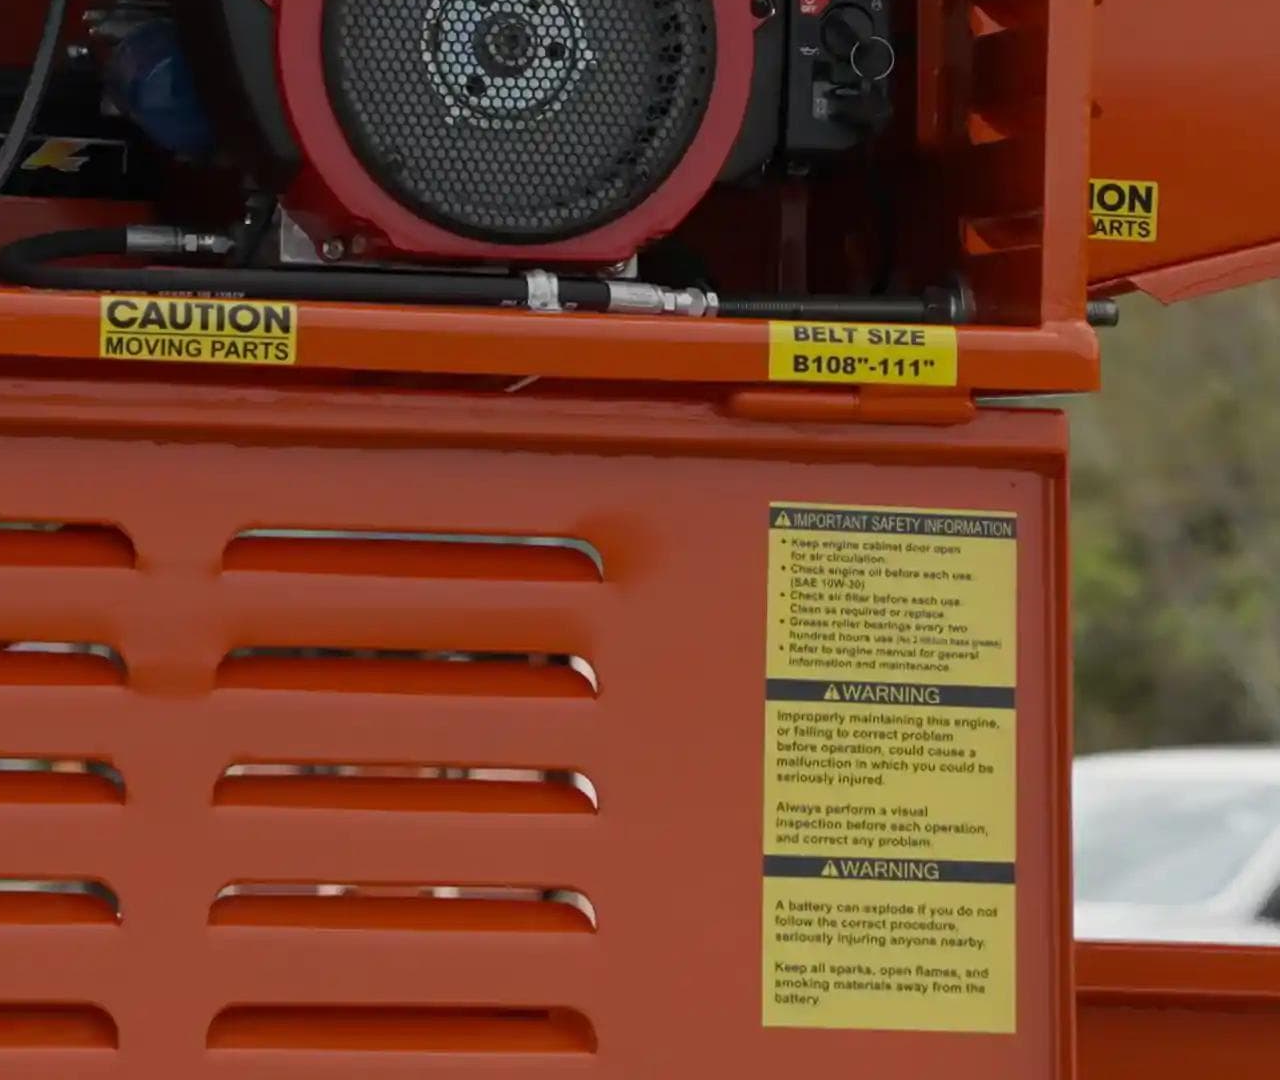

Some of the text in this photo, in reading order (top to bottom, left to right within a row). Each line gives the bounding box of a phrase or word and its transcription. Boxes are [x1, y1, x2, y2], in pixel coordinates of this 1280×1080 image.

[107, 299, 290, 334] CAUTION
[793, 325, 925, 346] BELT SIZE
[105, 336, 289, 361] MOVING PARTS
[793, 354, 935, 377] B108"-111"
[794, 514, 1011, 536] IMPORTANT SAFETY INFORMATION
[791, 537, 961, 555] Keep engine cabinet door open
[791, 550, 806, 560] for
[790, 563, 825, 574] Check
[827, 565, 865, 578] engine
[868, 566, 881, 576] oil
[884, 567, 919, 578] before
[922, 568, 949, 579] each
[789, 590, 824, 600] Check
[872, 593, 908, 603] before
[910, 594, 937, 604] each
[789, 603, 821, 613] Clean
[839, 605, 886, 618] required
[863, 618, 911, 632] bearings
[947, 622, 968, 632] two
[789, 630, 835, 642] hundred
[788, 642, 818, 653] Refer
[820, 644, 833, 653] to
[834, 644, 872, 657] engine
[918, 647, 934, 657] for
[937, 648, 979, 661] general
[788, 655, 852, 667] information
[854, 658, 876, 668] and
[842, 684, 941, 704] WARNING
[777, 711, 845, 724] Improperly
[848, 713, 923, 727] maintaining
[926, 715, 950, 725] this
[793, 726, 833, 739] failing
[836, 728, 849, 737] to
[852, 728, 897, 739] correct
[900, 729, 953, 743] problem
[777, 741, 817, 752] before
[888, 745, 924, 755] could
[927, 748, 965, 756] cause
[776, 757, 994, 773] malfunction in which you could be
[776, 772, 834, 785] seriously
[776, 802, 821, 815] Always
[825, 803, 875, 816] perform
[890, 805, 928, 815] visual
[776, 818, 842, 831] inspection
[845, 820, 886, 830] before
[889, 821, 920, 831] each
[776, 833, 799, 843] and
[802, 834, 848, 844] correct
[851, 837, 874, 847] any
[840, 860, 940, 880] WARNING
[775, 900, 784, 910] A
[788, 901, 832, 913] battery
[836, 904, 859, 912] can
[862, 903, 914, 916] explode
[917, 904, 925, 914] if
[929, 907, 953, 917] you
[956, 905, 973, 915] do
[775, 916, 813, 926] follow
[816, 917, 837, 927] the
[840, 918, 886, 928] correct
[775, 931, 833, 944] seriously
[836, 933, 886, 946] injuring
[889, 936, 936, 947] anyone
[775, 962, 807, 974] Keep
[810, 963, 825, 973] all
[879, 967, 911, 978] open
[964, 967, 988, 977] and
[775, 977, 985, 993] smoking materials away from the
